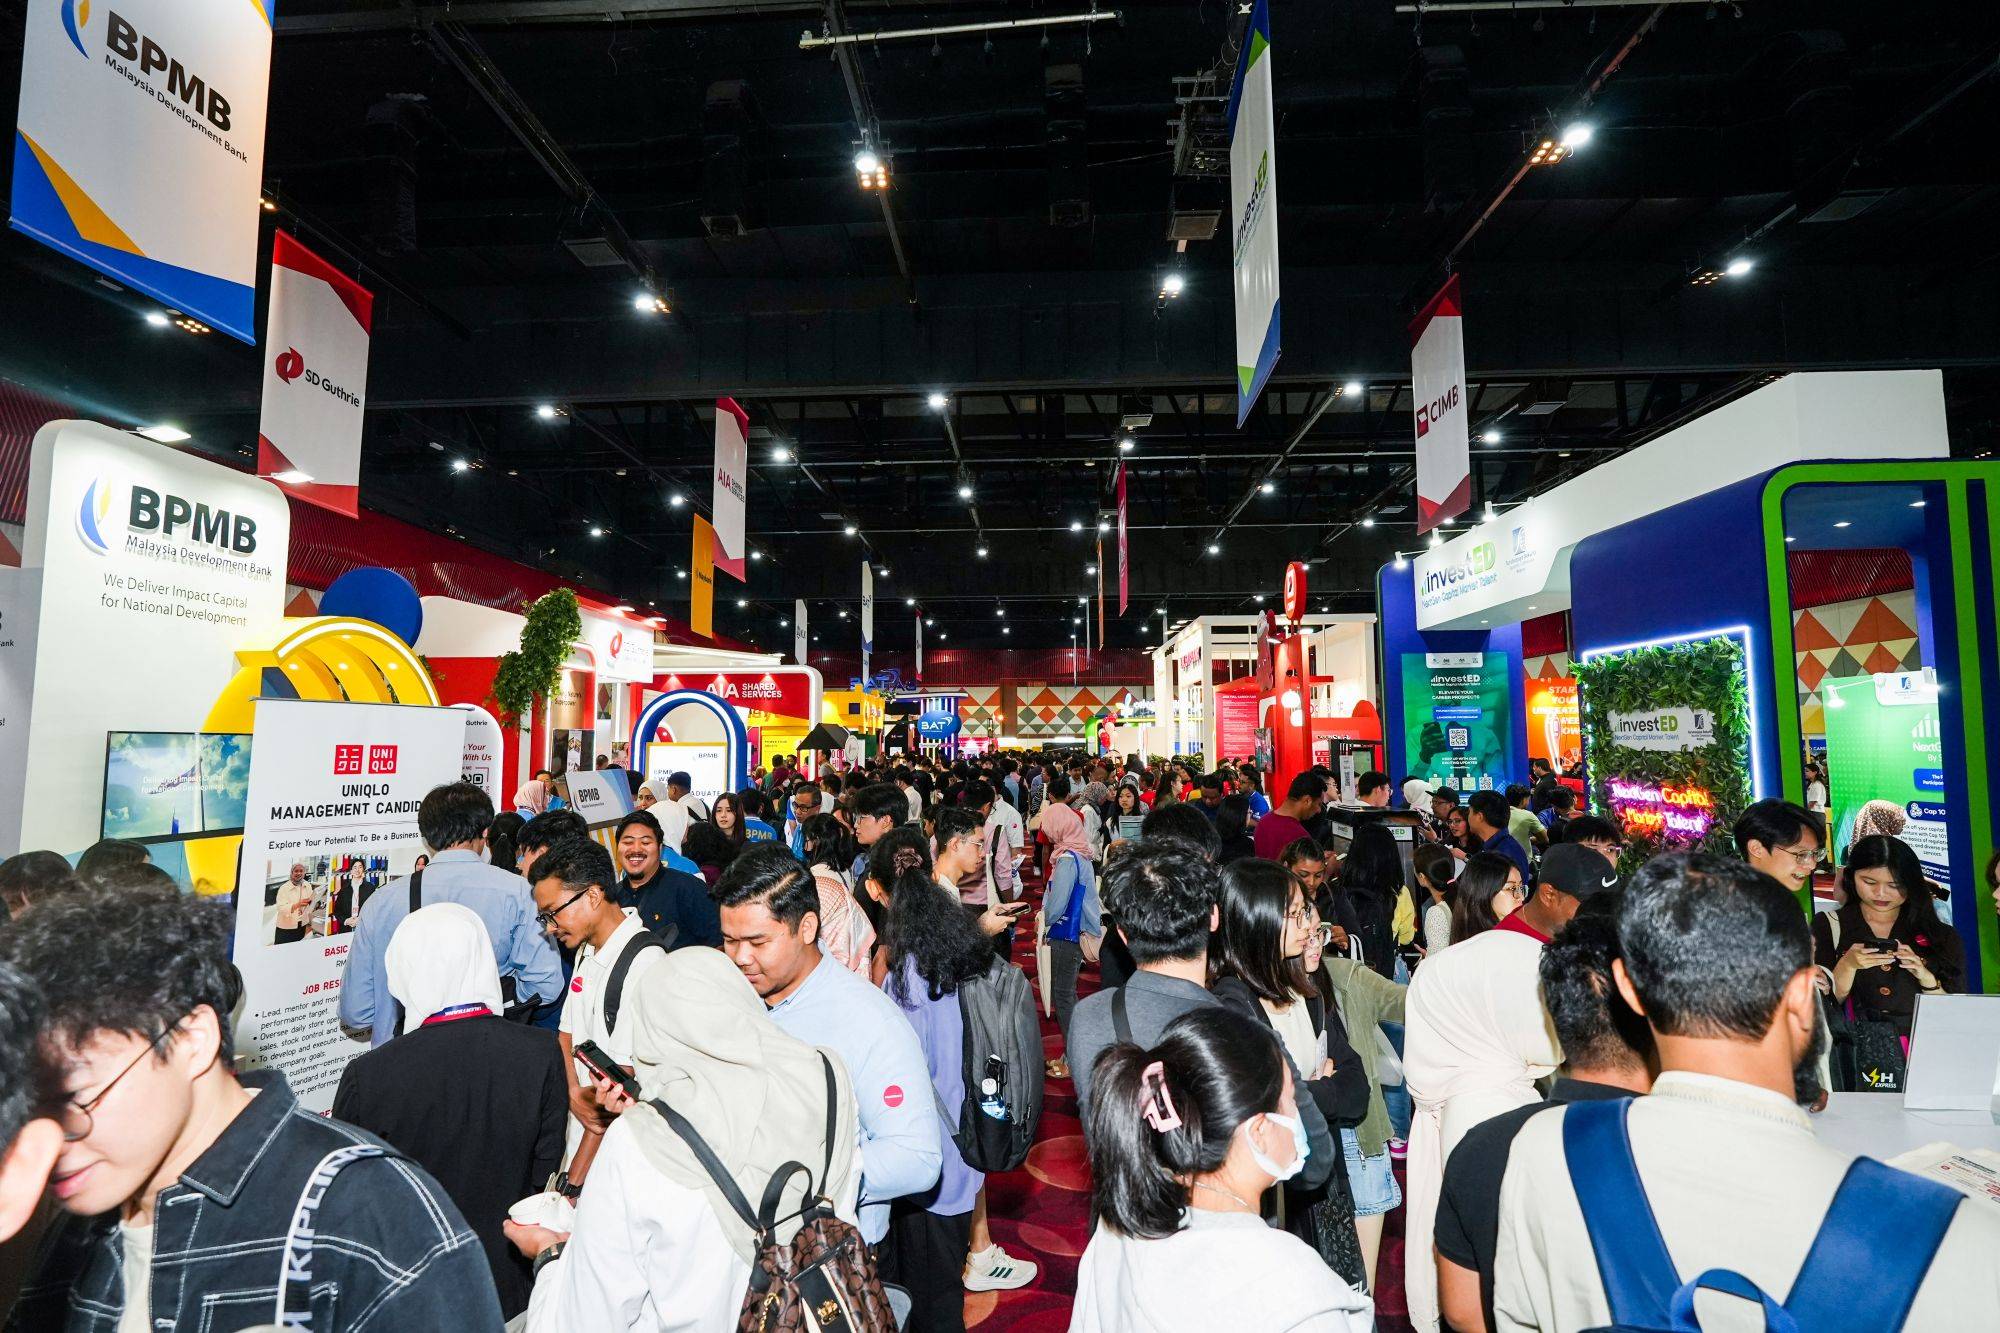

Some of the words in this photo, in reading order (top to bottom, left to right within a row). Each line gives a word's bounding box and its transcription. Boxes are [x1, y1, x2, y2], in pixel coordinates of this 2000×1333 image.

[106, 10, 231, 132] BPMB
[105, 54, 155, 96] Malaysia
[157, 91, 222, 146] Development
[224, 141, 248, 163] Bank
[305, 369, 320, 386] SD
[322, 379, 360, 408] Guthrie
[1431, 385, 1459, 422] CIMB
[718, 467, 731, 490] AIA
[129, 485, 257, 555] BPMB
[126, 535, 177, 557] Malaysia
[180, 547, 248, 572] Development
[249, 563, 272, 577] Bank
[1425, 542, 1496, 593] investED
[104, 573, 124, 587] We
[127, 577, 170, 595] Deliver
[172, 585, 210, 604] Impact
[213, 593, 248, 609] Capital
[101, 593, 119, 608] for
[123, 597, 173, 616] National
[176, 605, 247, 627] Development
[742, 683, 776, 691] SHARED
[1435, 675, 1480, 683] investED
[705, 683, 739, 698] AIA
[742, 690, 782, 698] SERVICES
[922, 722, 946, 730] BAT
[1619, 715, 1678, 732] investED
[372, 748, 394, 759] UNI
[1928, 754, 1936, 763] By
[371, 760, 394, 772] QLO
[342, 783, 390, 798] UNIQLO
[578, 788, 600, 802] BPMB
[1662, 787, 1709, 807] Capital
[271, 802, 370, 820] MANAGEMENT
[1923, 808, 1937, 816] Cap
[268, 840, 301, 850] Explore
[305, 838, 321, 847] Your
[324, 835, 357, 845] Potential
[360, 834, 368, 842] To
[371, 833, 381, 842] Be
[390, 831, 419, 840] Business
[324, 945, 348, 957] BASIC
[302, 984, 320, 995] JOB
[323, 979, 342, 990] RES
[284, 1002, 310, 1013] mentor
[312, 998, 323, 1007] and
[260, 1014, 306, 1031] performance
[260, 1029, 289, 1041] Oversee
[291, 1023, 306, 1033] daily
[308, 1020, 324, 1029] store
[281, 1037, 299, 1047] stock
[301, 1029, 324, 1042] control
[326, 1026, 338, 1034] and
[270, 1047, 297, 1060] develop
[298, 1045, 311, 1053] and
[312, 1037, 337, 1049] execute
[276, 1056, 306, 1070] company
[290, 1073, 318, 1088] standard
[320, 1070, 327, 1079] of
